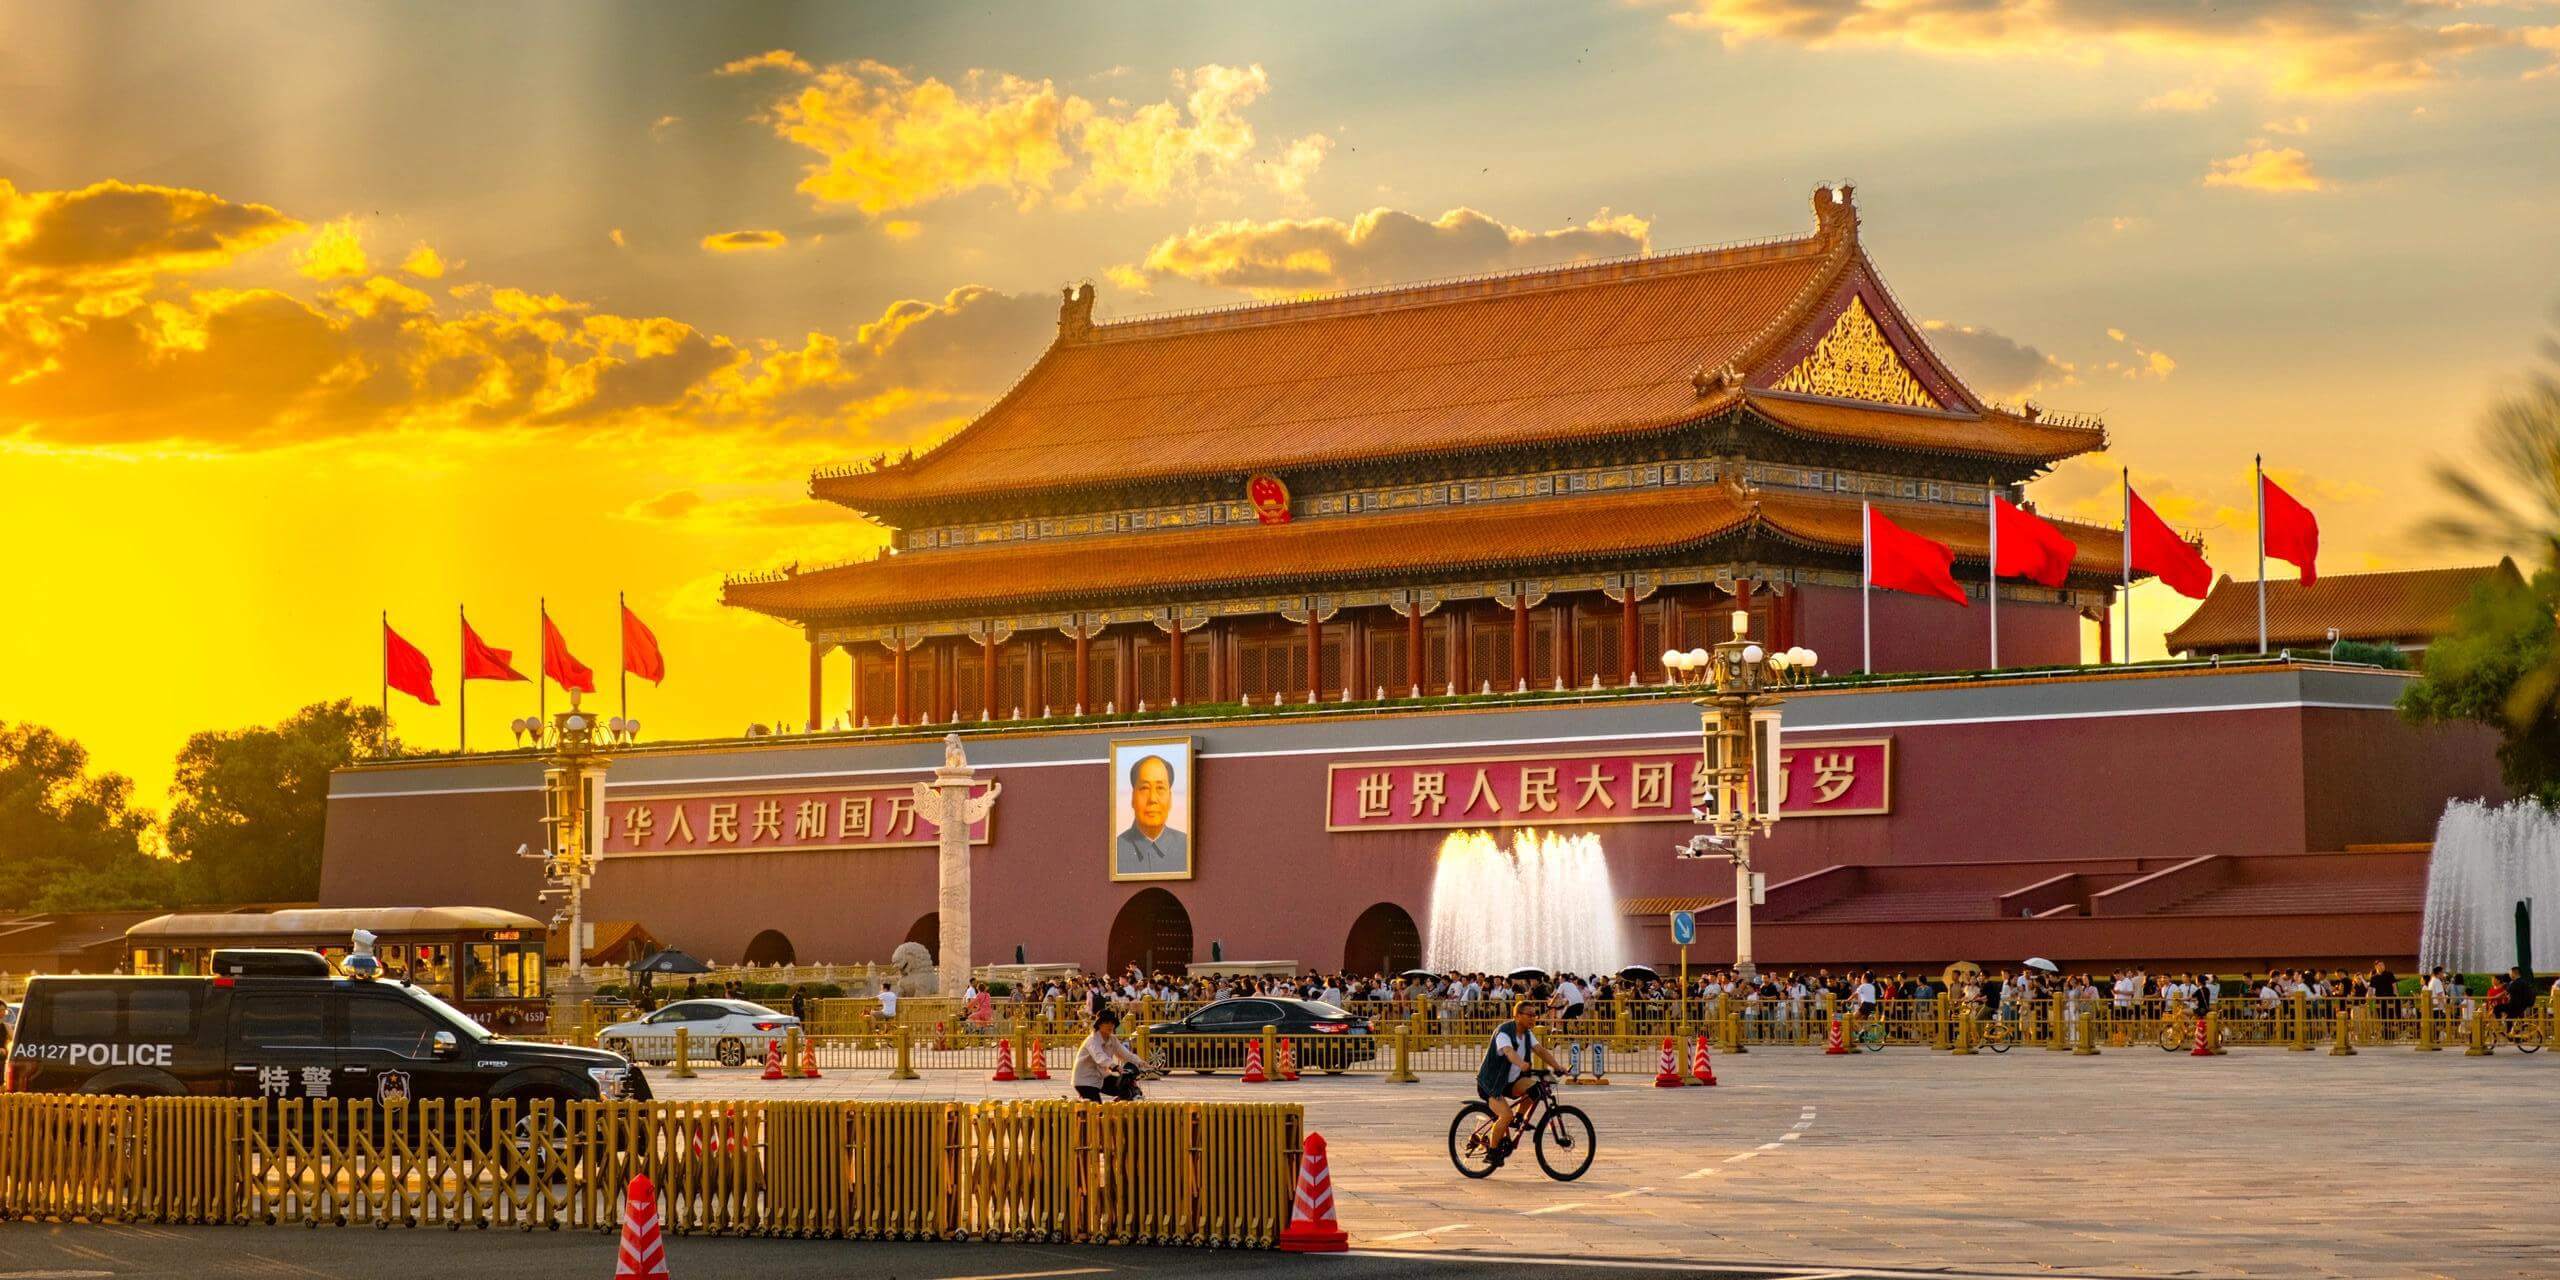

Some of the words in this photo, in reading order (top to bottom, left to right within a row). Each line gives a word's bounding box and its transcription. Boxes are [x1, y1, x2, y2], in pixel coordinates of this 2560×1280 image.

[603, 796, 941, 847] 华人民共和国万
[14, 1043, 68, 1059] A8127
[69, 1043, 173, 1066] POLICE
[259, 1066, 332, 1097] 特警
